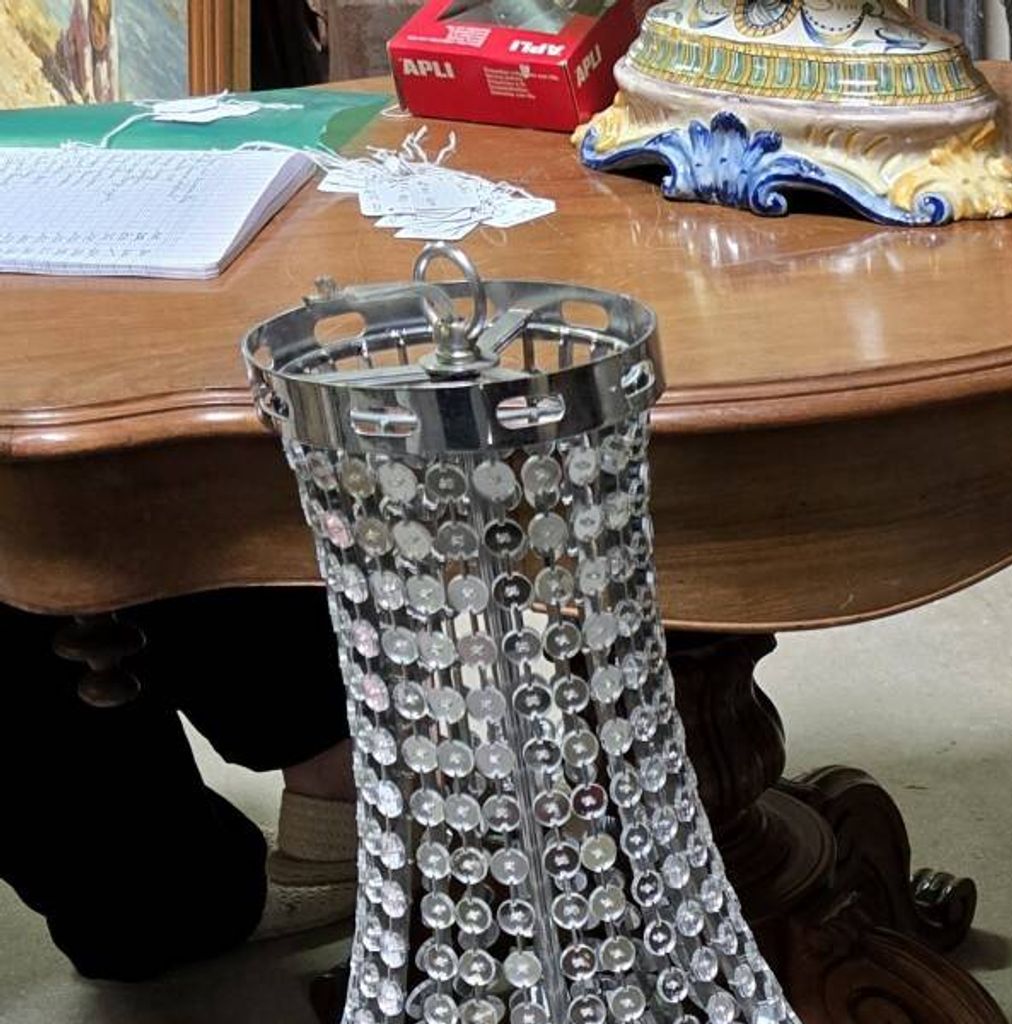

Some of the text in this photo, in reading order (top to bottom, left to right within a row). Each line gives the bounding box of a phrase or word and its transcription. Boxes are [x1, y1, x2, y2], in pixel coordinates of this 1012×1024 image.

[509, 39, 566, 56] APLI
[402, 58, 456, 79] APLI
[574, 44, 603, 88] APLI
